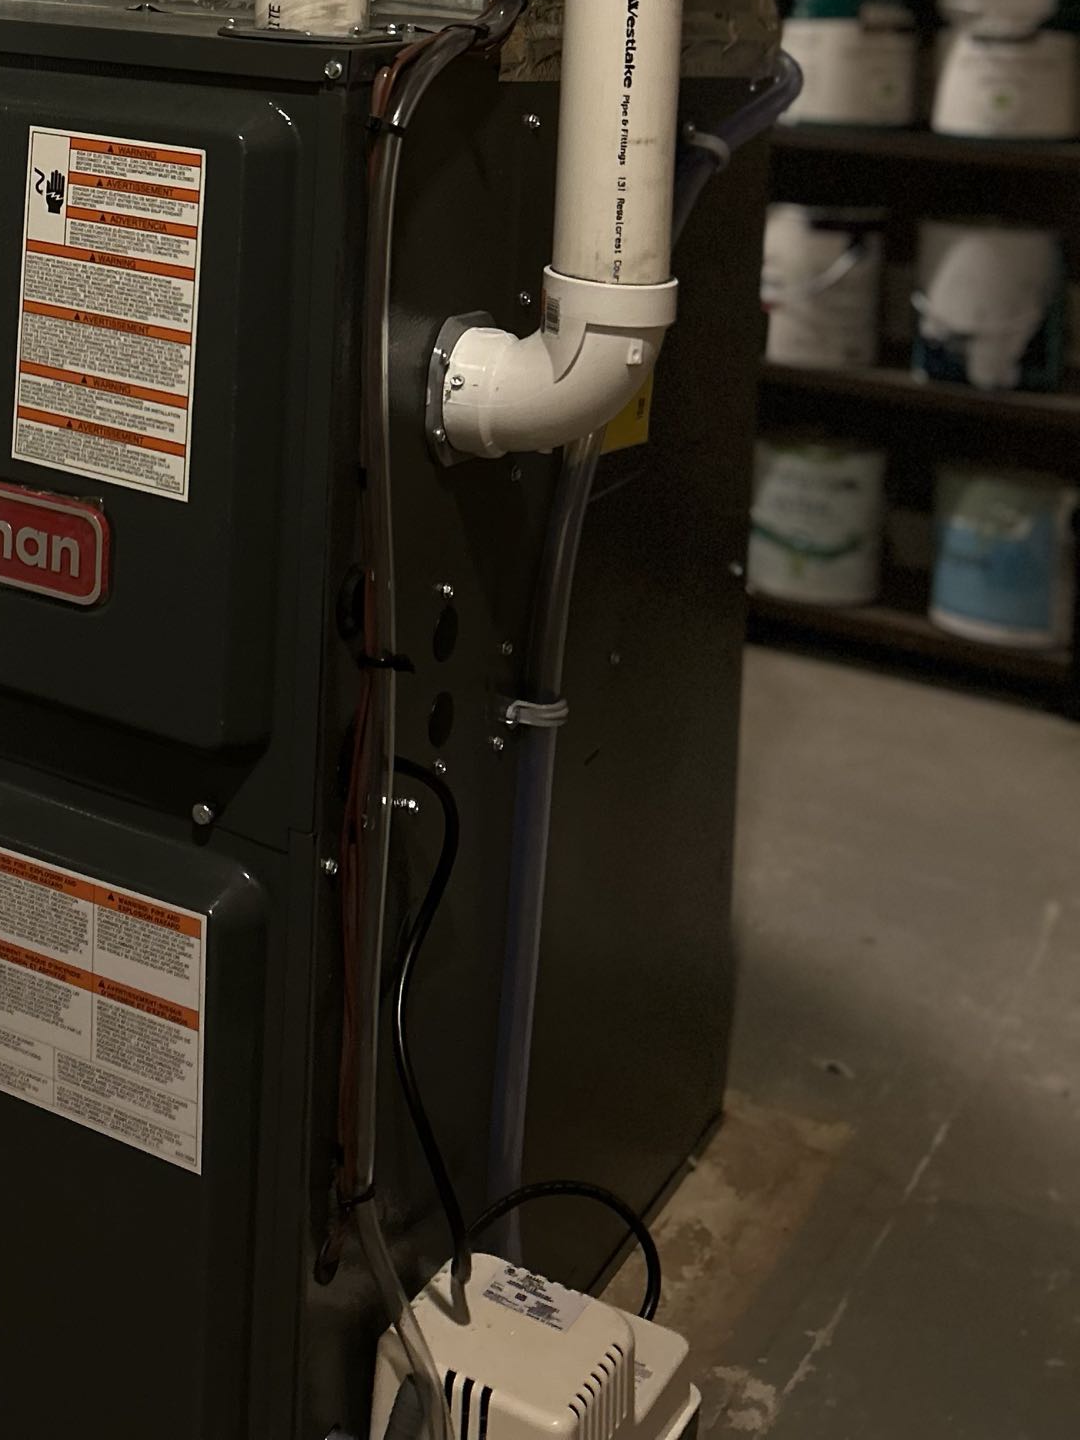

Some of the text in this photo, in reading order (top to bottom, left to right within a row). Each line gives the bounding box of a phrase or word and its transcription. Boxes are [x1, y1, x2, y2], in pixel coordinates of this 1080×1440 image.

[620, 95, 631, 117] Pipe
[118, 146, 157, 159] WARNING
[618, 129, 630, 166] Fittings
[106, 179, 174, 197] AVERTISSEMENT
[110, 215, 167, 233] ADVERTENCIA
[98, 253, 136, 268] WARNING
[83, 315, 150, 334] AVERTISSEMENT
[93, 379, 131, 394] WARNING
[78, 423, 145, 445] AVERTISSEMENT
